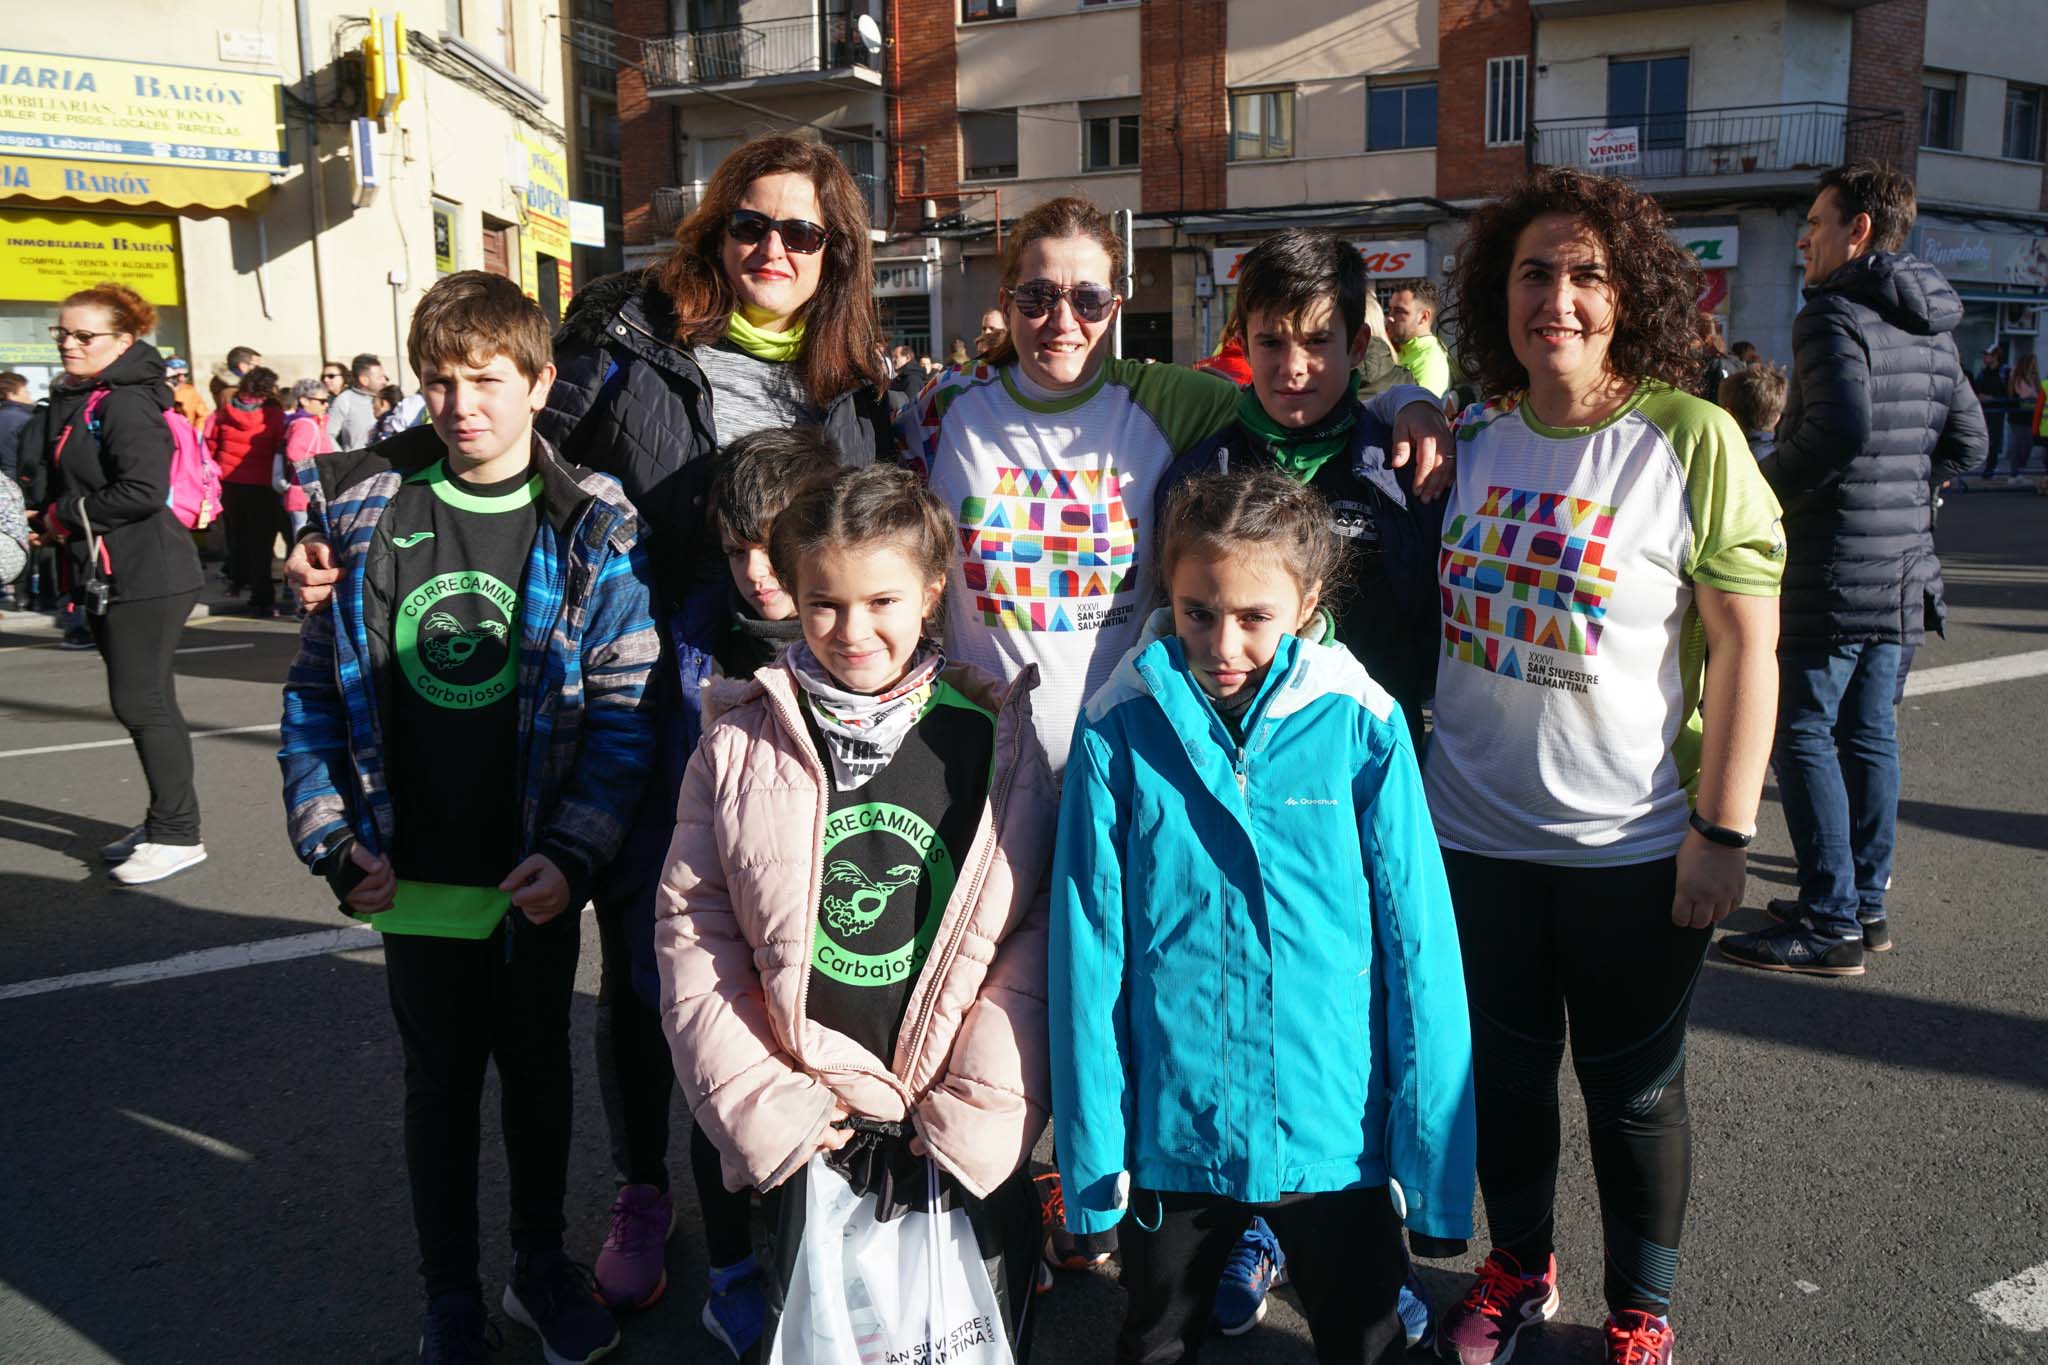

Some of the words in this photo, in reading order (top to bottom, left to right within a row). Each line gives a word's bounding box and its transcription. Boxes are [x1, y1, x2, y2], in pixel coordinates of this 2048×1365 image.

[134, 75, 243, 105] BARÓN
[48, 136, 123, 153] Laborales
[177, 146, 207, 159] 923
[216, 149, 230, 161] 12
[232, 150, 252, 162] 24
[1589, 143, 1637, 157] VENDE
[64, 168, 150, 194] BARÓN
[7, 238, 105, 249] INMOBILIARIA
[112, 237, 175, 253] BARÓN
[1077, 603, 1099, 612] XXXVI
[1077, 611, 1094, 622] SAN
[1096, 603, 1135, 620] SILVESTRE
[1077, 615, 1128, 631] SALMANTINA
[1529, 651, 1554, 666] XXXVI
[1526, 673, 1588, 694] SALMANTINA
[1527, 662, 1546, 675] SAN
[1548, 666, 1599, 685] SILVESTRE
[417, 675, 505, 706] Carbajosa
[817, 945, 926, 982] Carbajosa
